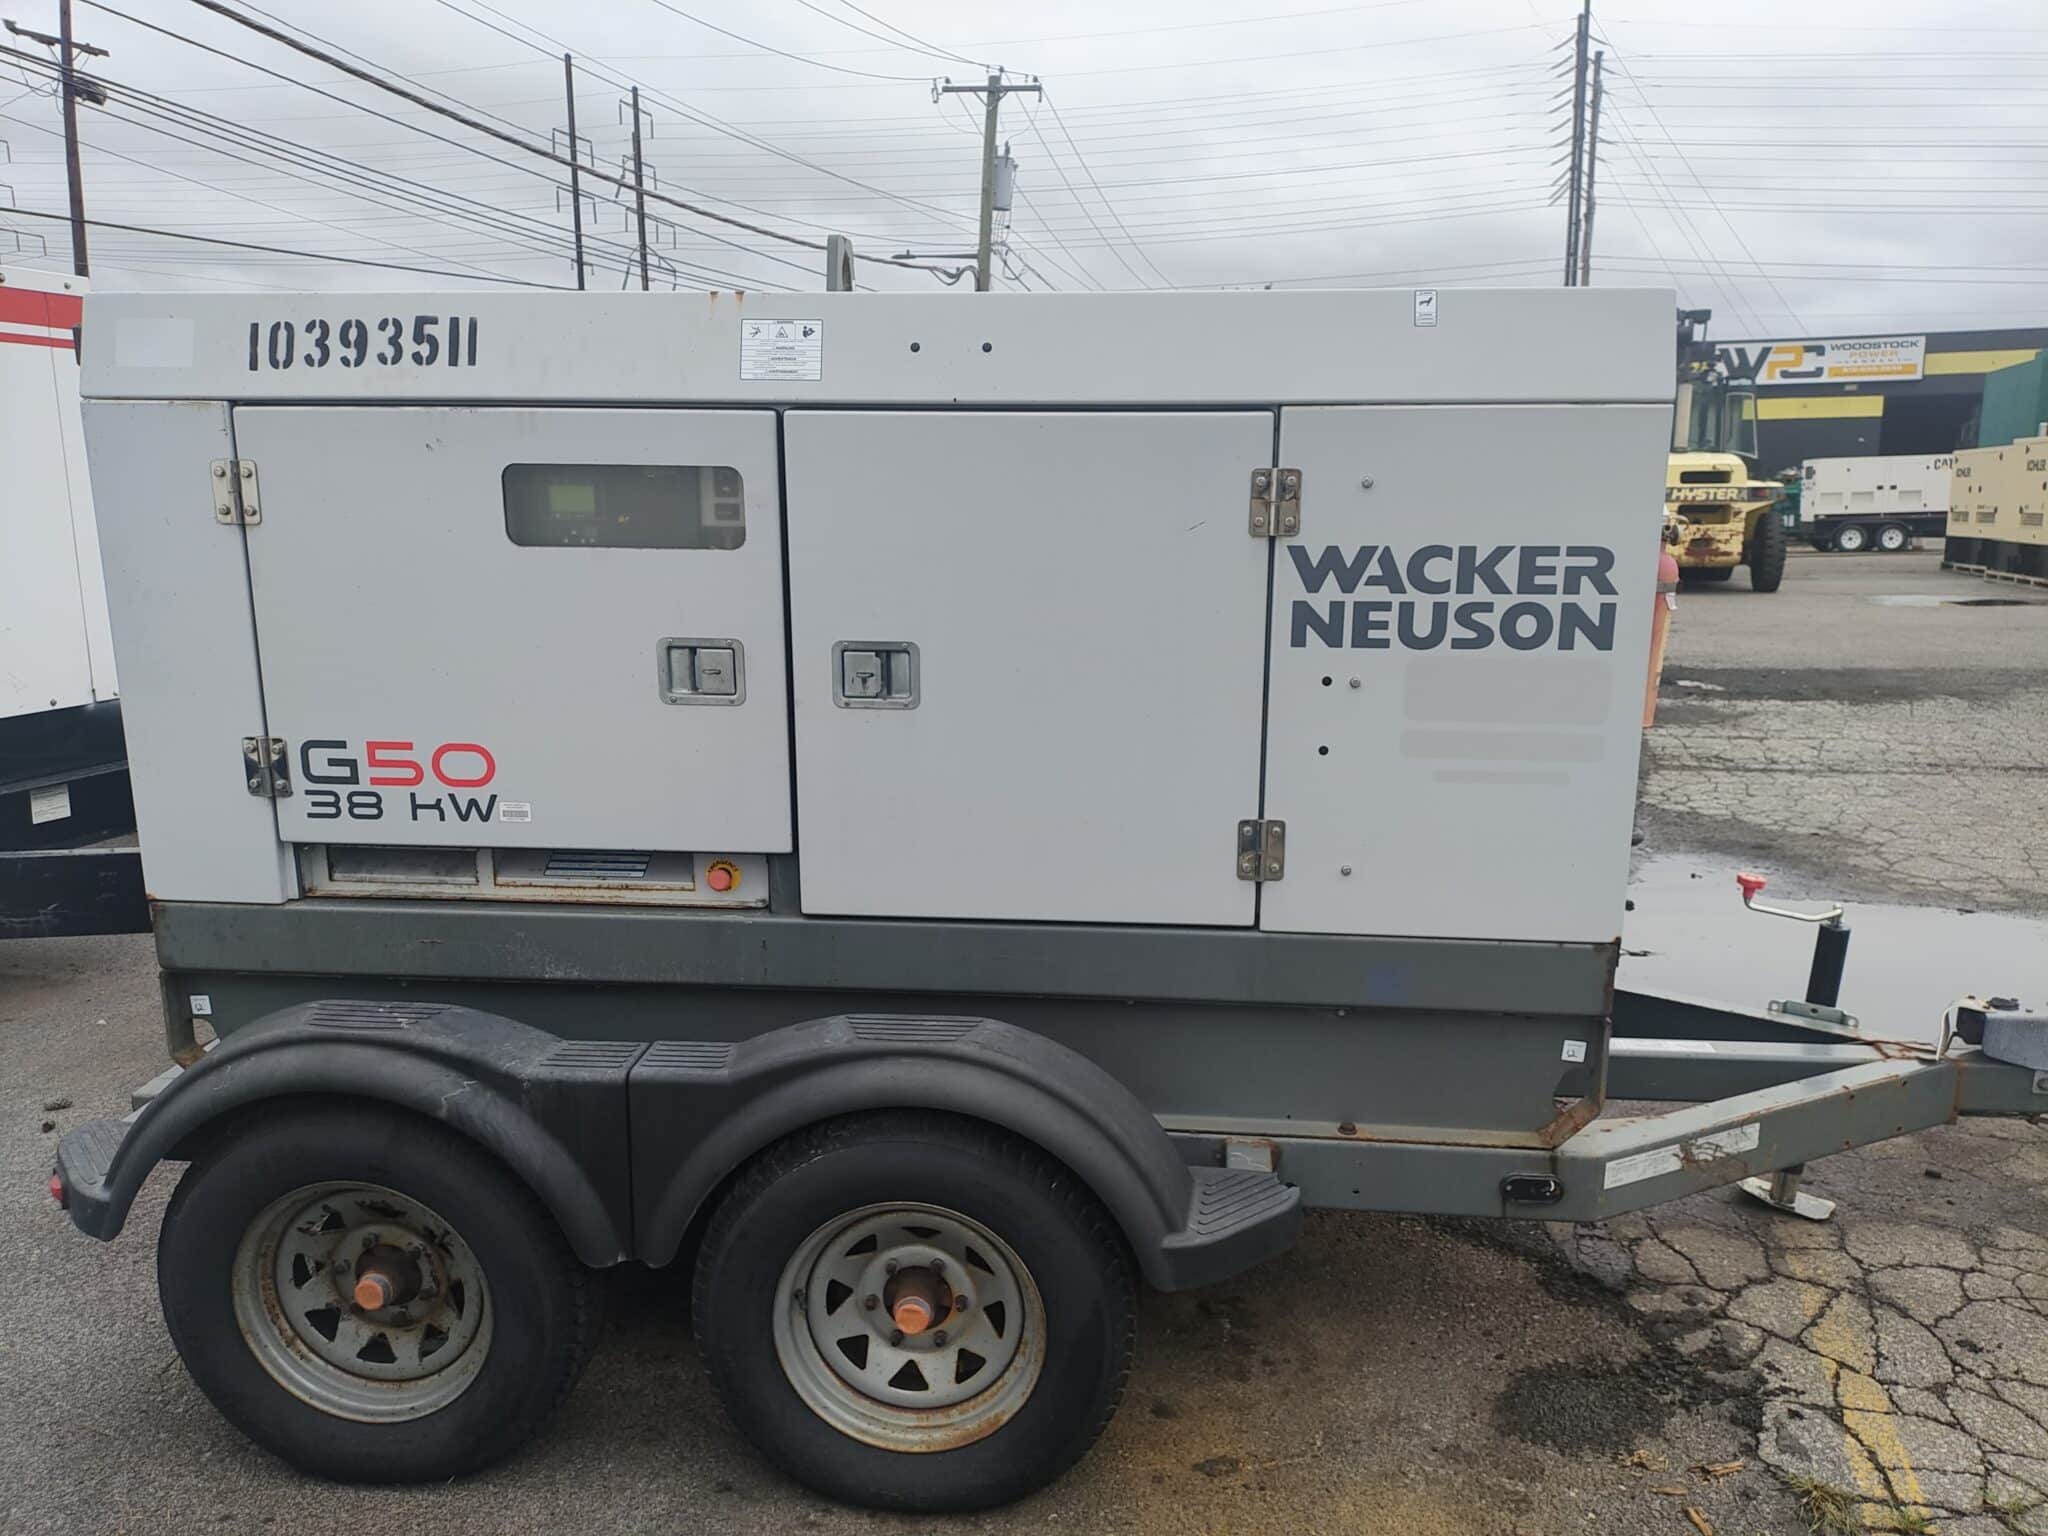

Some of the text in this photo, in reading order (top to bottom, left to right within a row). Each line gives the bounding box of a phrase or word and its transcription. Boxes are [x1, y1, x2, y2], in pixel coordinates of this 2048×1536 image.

[249, 315, 478, 371] 10393511
[1829, 340, 1920, 351] WOODSTOCK
[1671, 487, 1738, 500] HYSTER
[1287, 544, 1619, 595] WACKER
[1290, 600, 1617, 651] NEUSON
[300, 740, 496, 788] G50
[304, 789, 384, 820] 38
